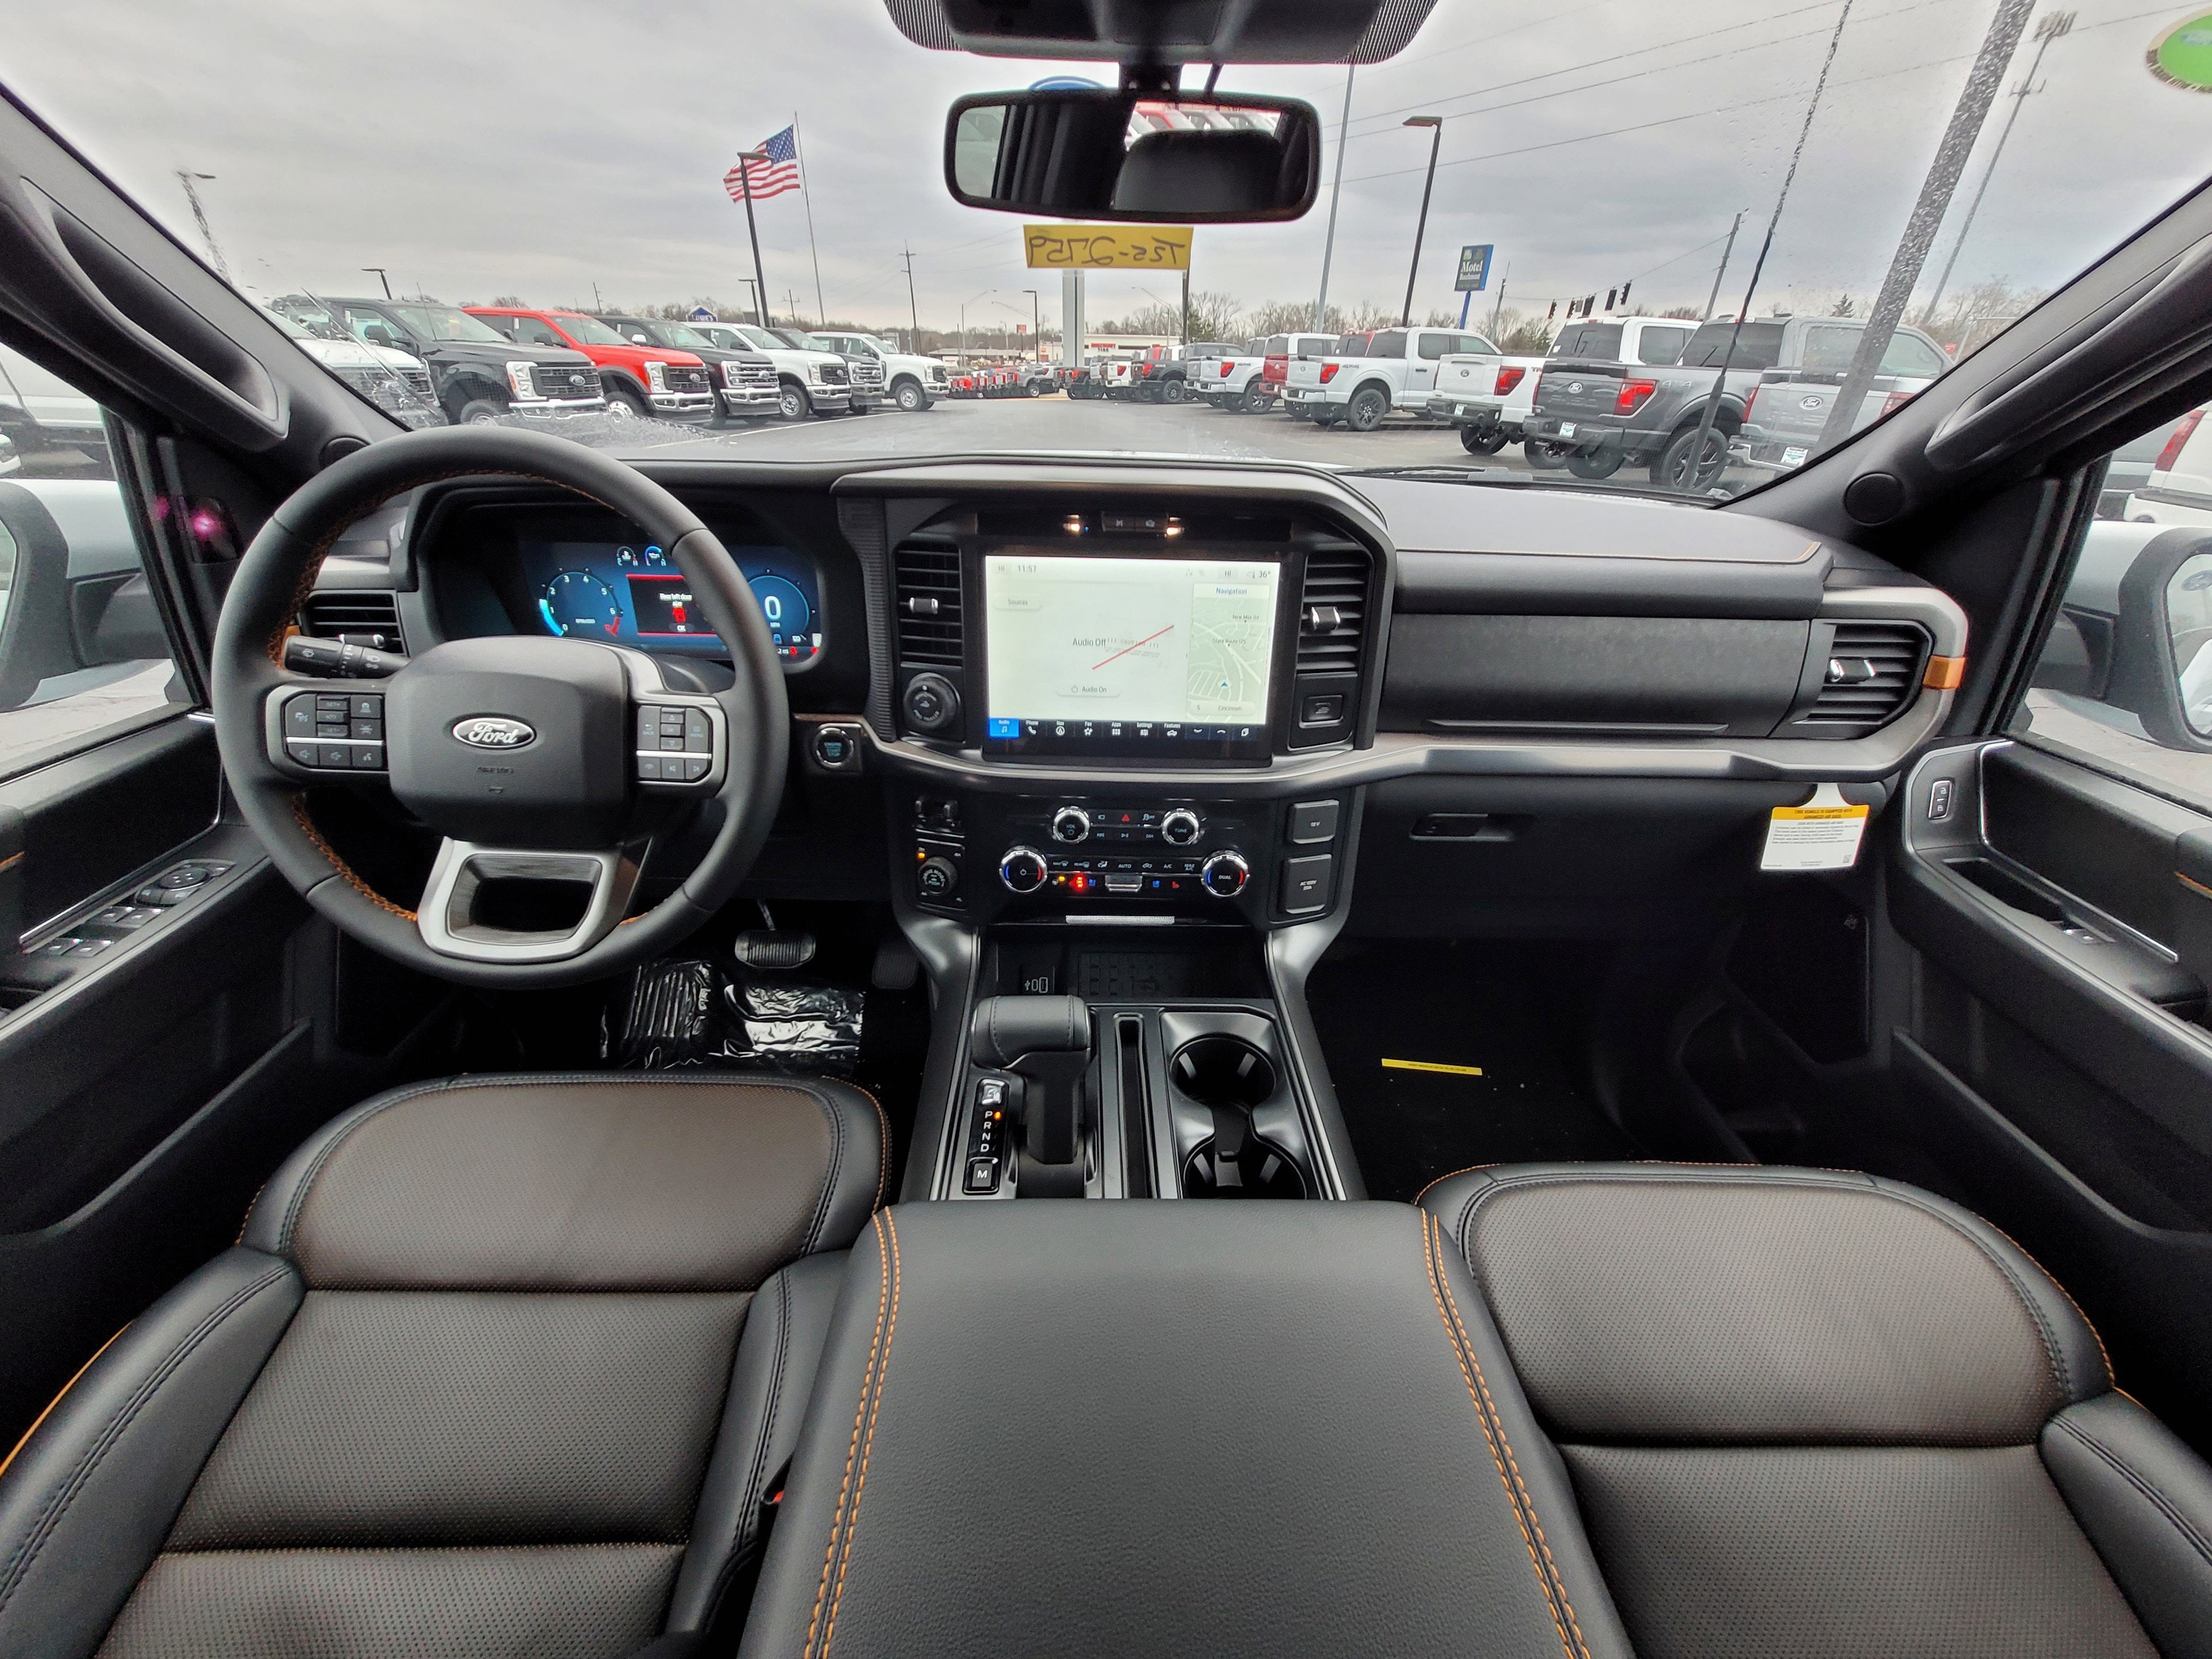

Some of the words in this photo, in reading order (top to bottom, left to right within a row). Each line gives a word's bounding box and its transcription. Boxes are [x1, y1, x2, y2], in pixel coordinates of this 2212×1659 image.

[1460, 259, 1483, 272] Motel
[1018, 565, 1037, 573] 11:57
[1216, 587, 1247, 596] Navigation
[765, 596, 781, 620] 0
[1073, 638, 1093, 647] Audio
[1095, 638, 1106, 647] Off
[467, 721, 520, 744] Ford
[982, 1132, 990, 1140] N
[980, 1143, 989, 1152] D
[977, 1170, 988, 1178] M
